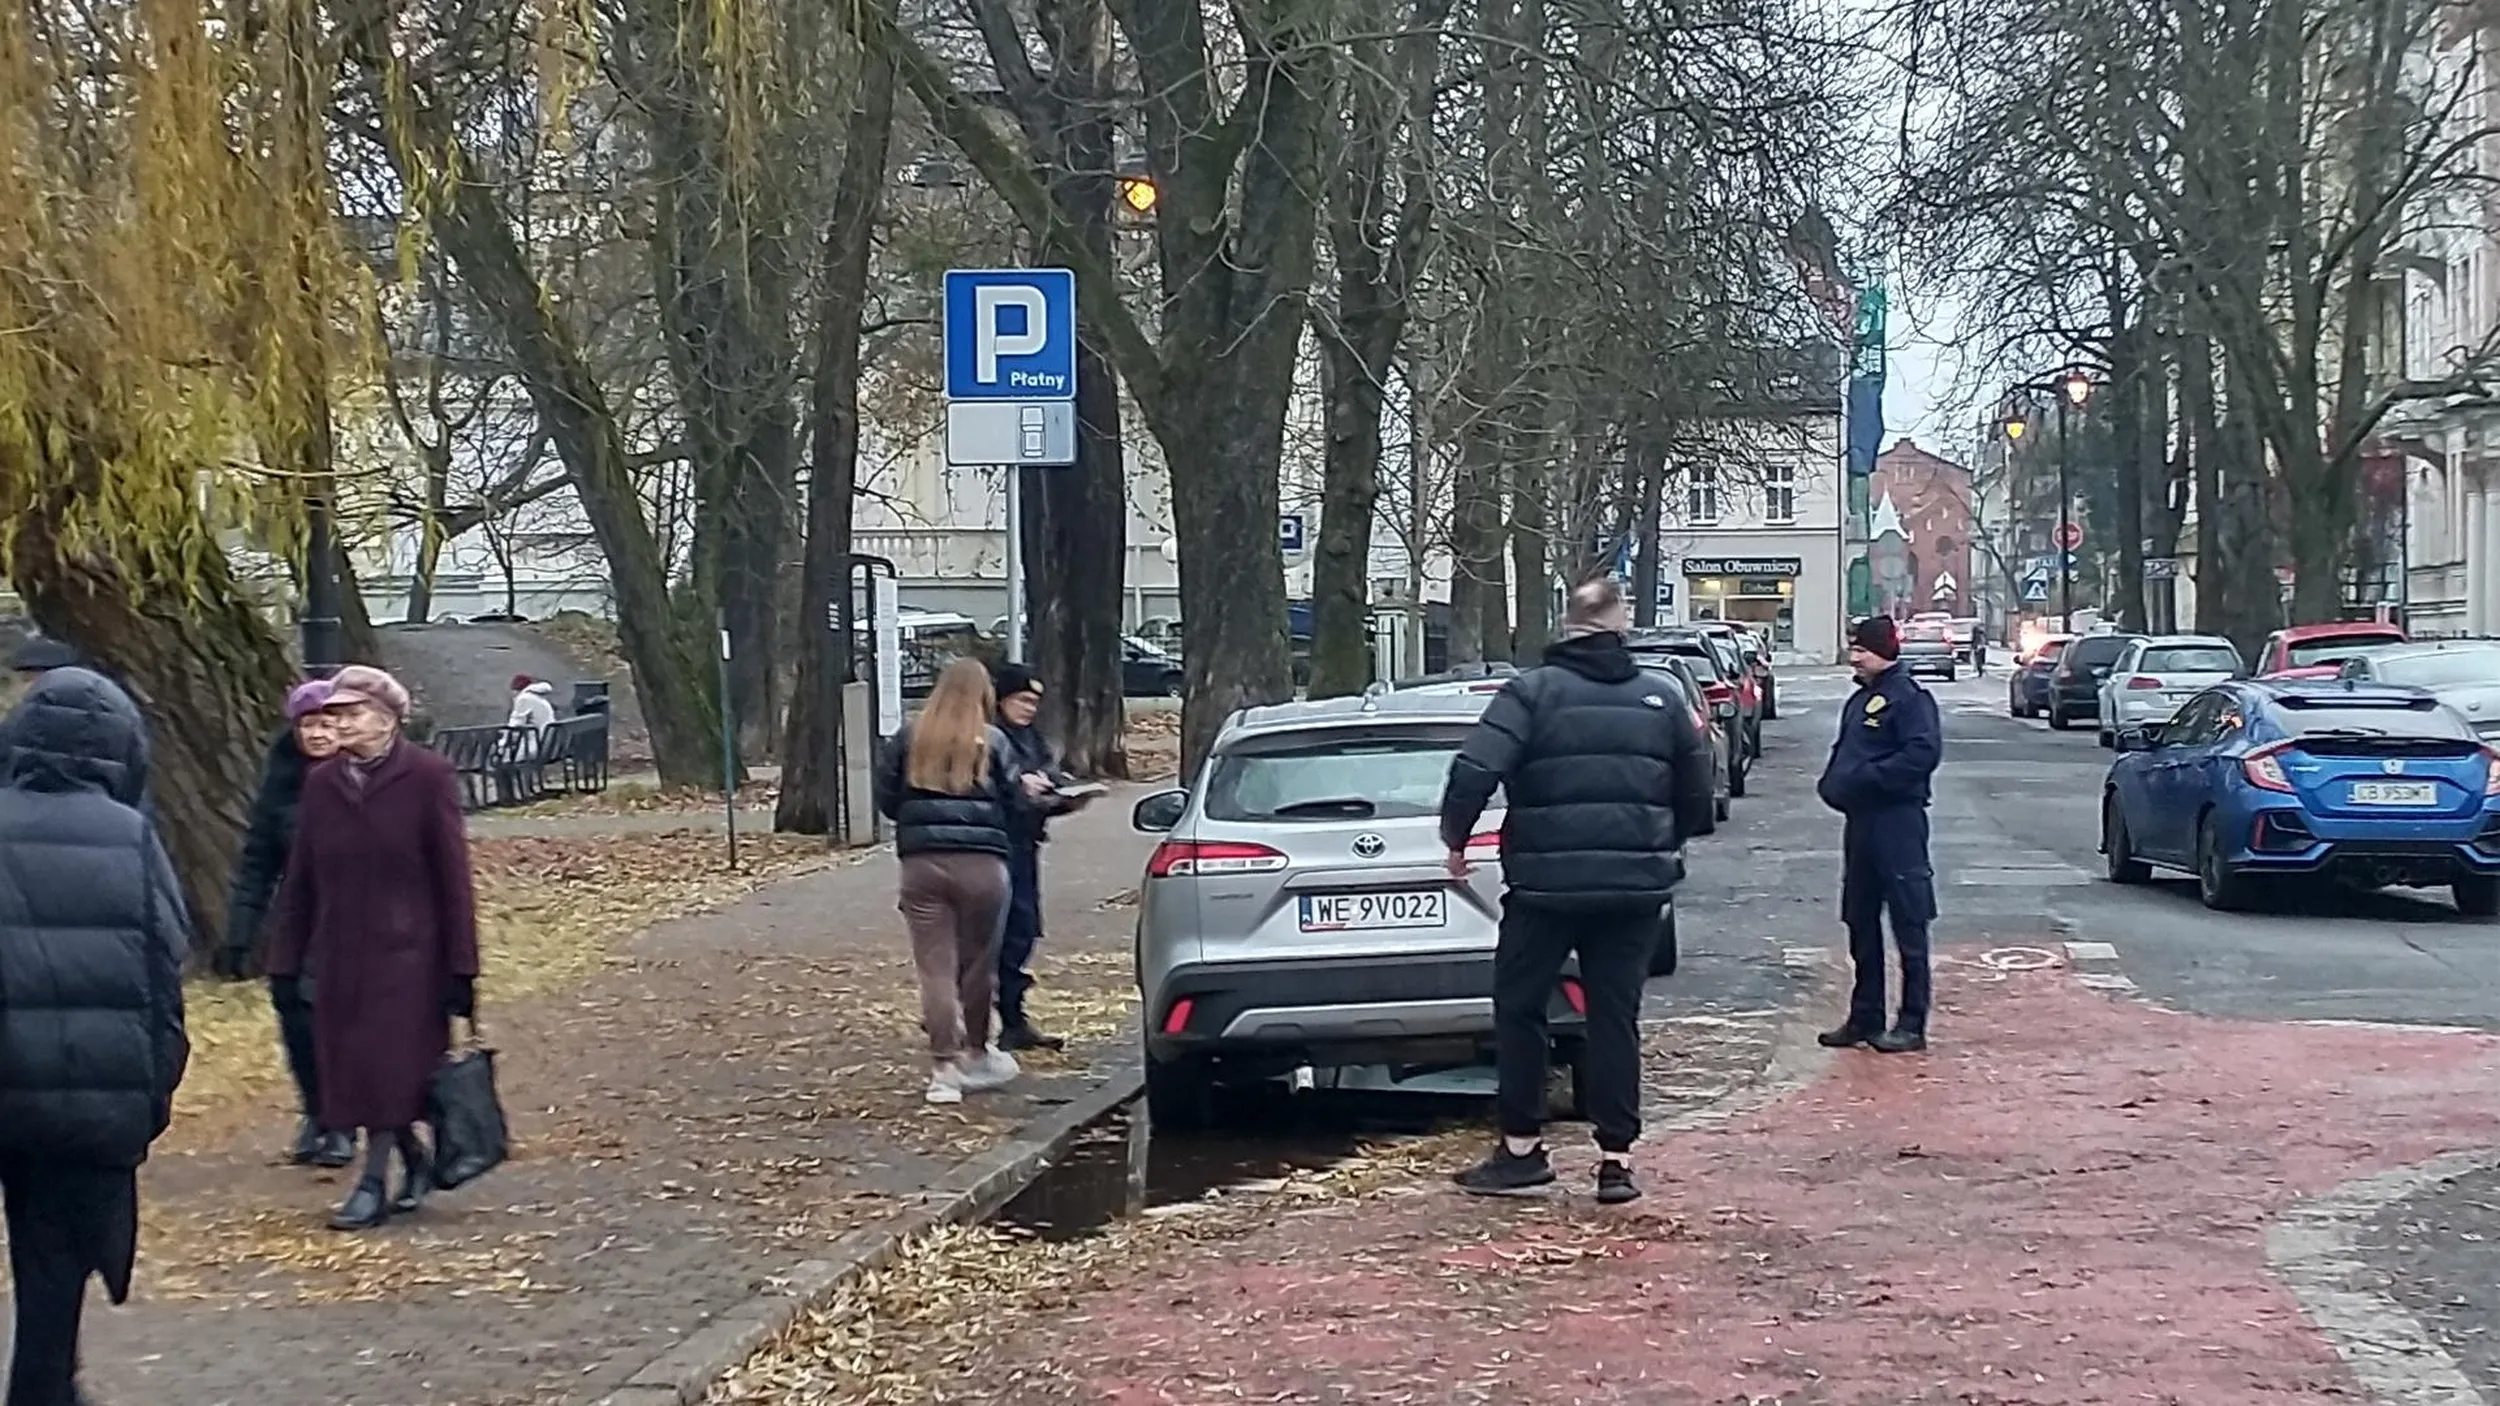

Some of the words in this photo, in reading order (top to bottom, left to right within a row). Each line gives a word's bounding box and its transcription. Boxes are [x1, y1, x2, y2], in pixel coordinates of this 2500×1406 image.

[976, 285, 1046, 383] P
[1685, 560, 1722, 573] Salon
[1656, 585, 1670, 603] P
[1318, 898, 1350, 922] WE
[1360, 895, 1438, 920] 9V022
